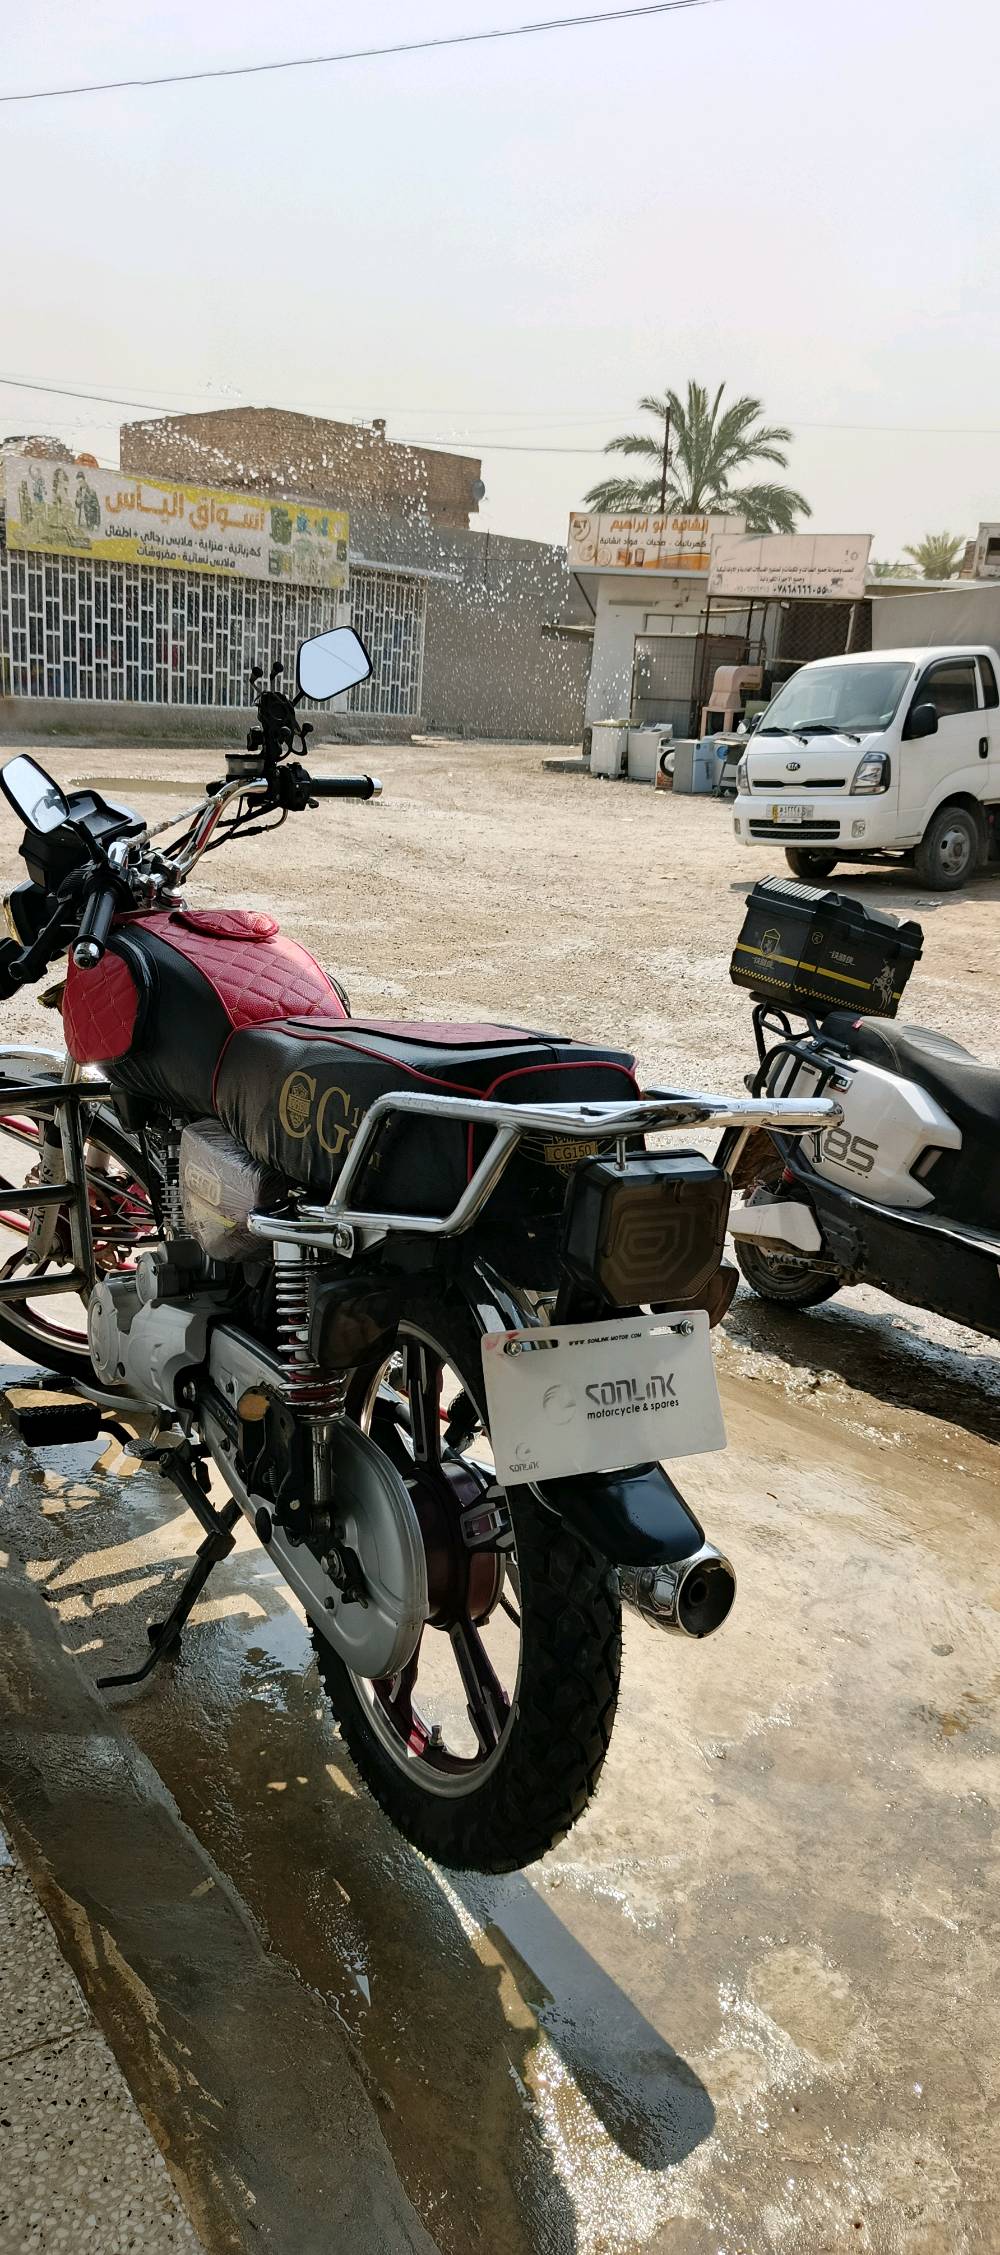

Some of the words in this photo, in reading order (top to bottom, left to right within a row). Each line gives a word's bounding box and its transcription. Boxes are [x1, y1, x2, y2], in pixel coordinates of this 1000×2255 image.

[553, 1144, 592, 1160] CG150
[587, 1404, 641, 1420] motorcycle
[642, 1402, 649, 1411] &
[650, 1398, 680, 1412] spares
